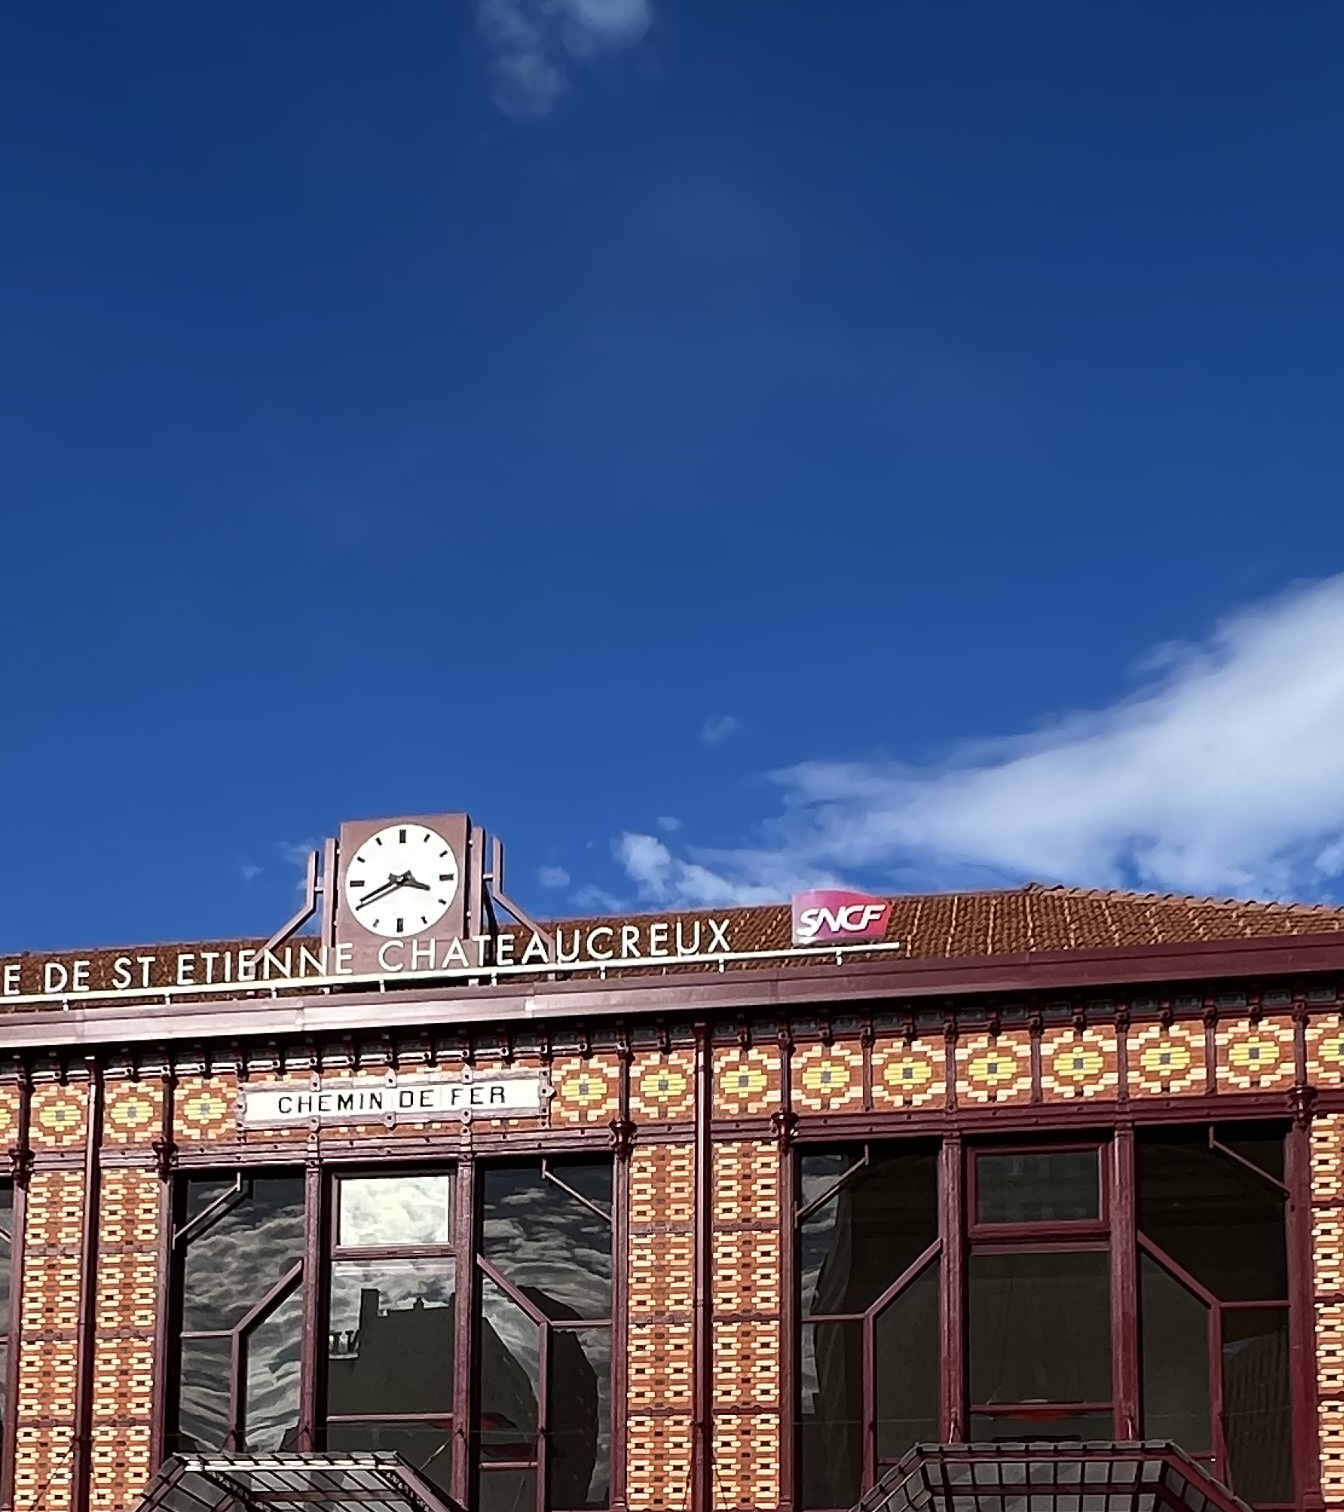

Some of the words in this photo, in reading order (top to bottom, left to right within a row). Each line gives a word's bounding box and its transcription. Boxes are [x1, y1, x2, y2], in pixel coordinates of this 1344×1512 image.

[796, 904, 887, 937] SNCF
[44, 960, 91, 993] DE
[112, 956, 156, 990] ST
[176, 942, 353, 986] ETIENNE
[378, 918, 732, 972] CHATEAUCREUX
[278, 1092, 384, 1114] CHEMIN
[399, 1089, 434, 1108] DE
[451, 1086, 506, 1106] FER
